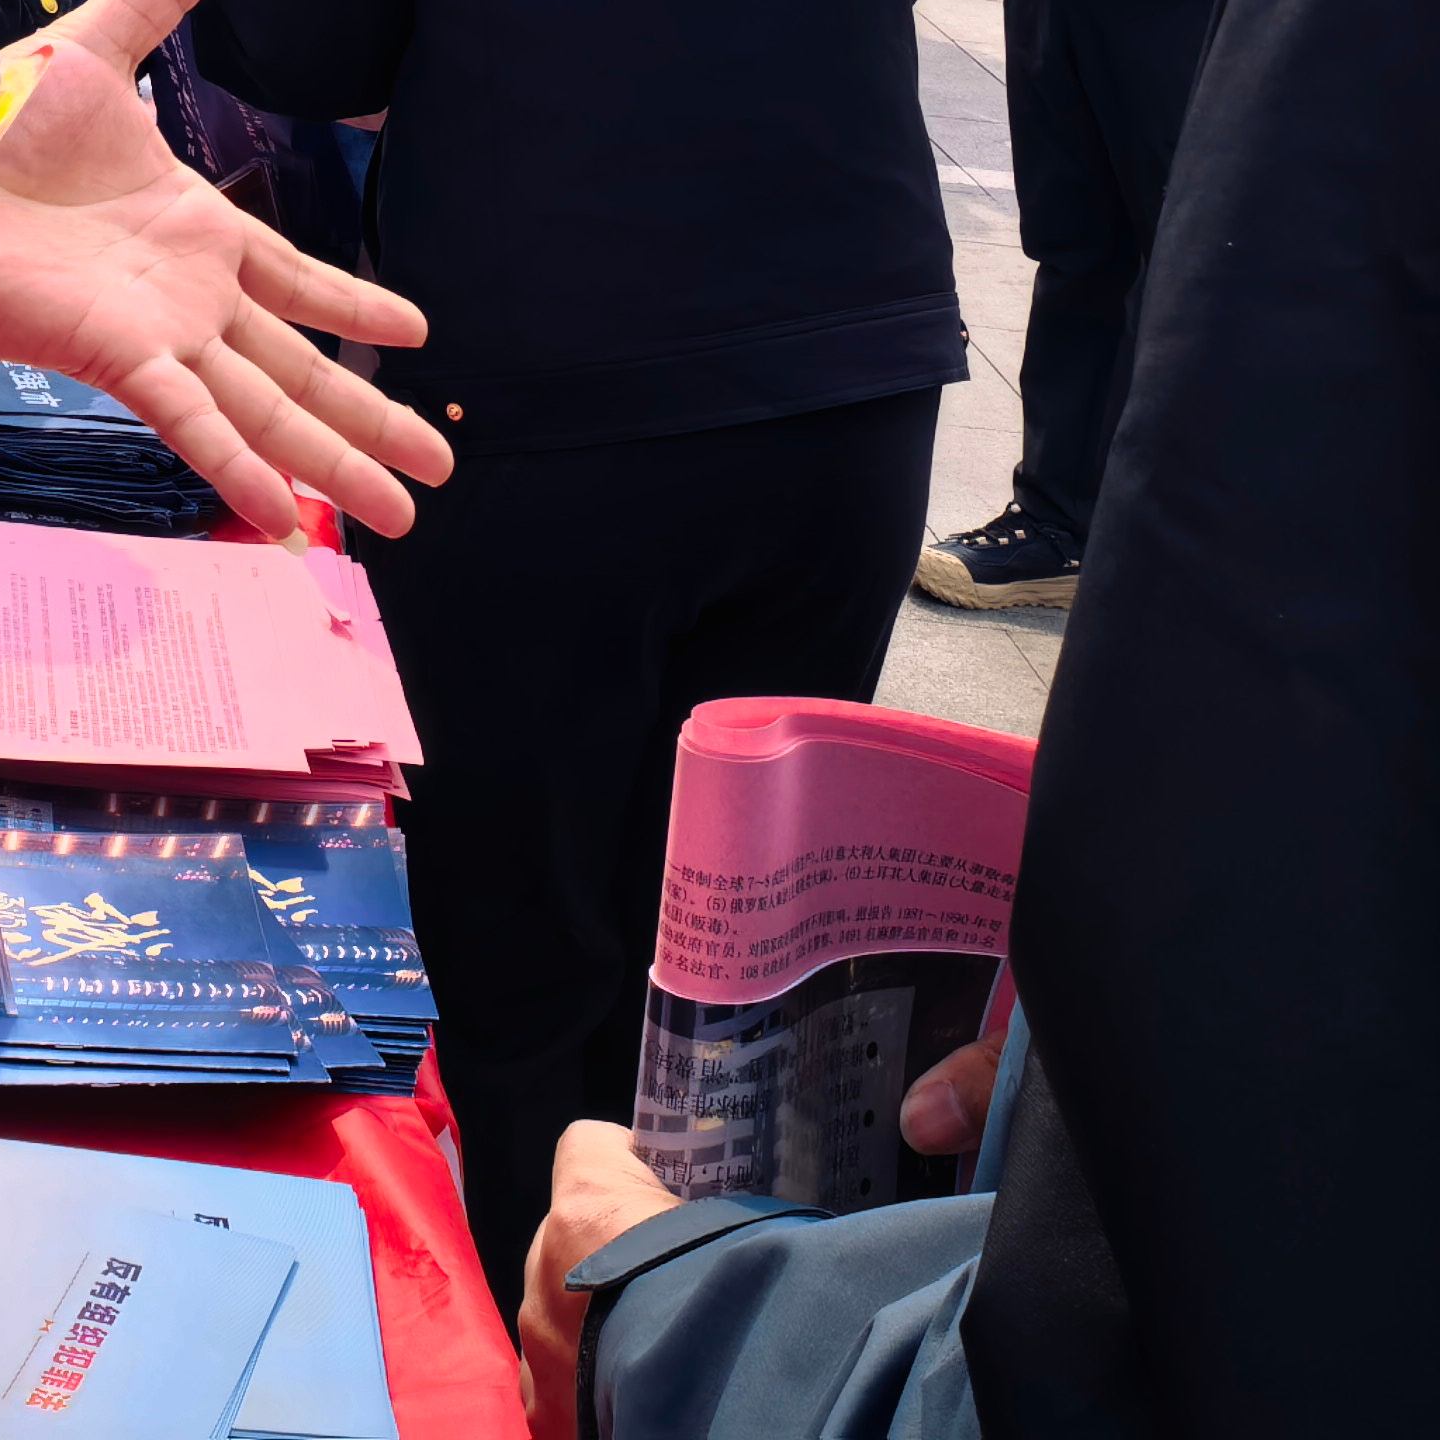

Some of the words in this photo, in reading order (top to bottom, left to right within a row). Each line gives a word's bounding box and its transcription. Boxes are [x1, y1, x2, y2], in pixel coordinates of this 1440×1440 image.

[25, 1256, 142, 1412] 反有组织犯罪法
